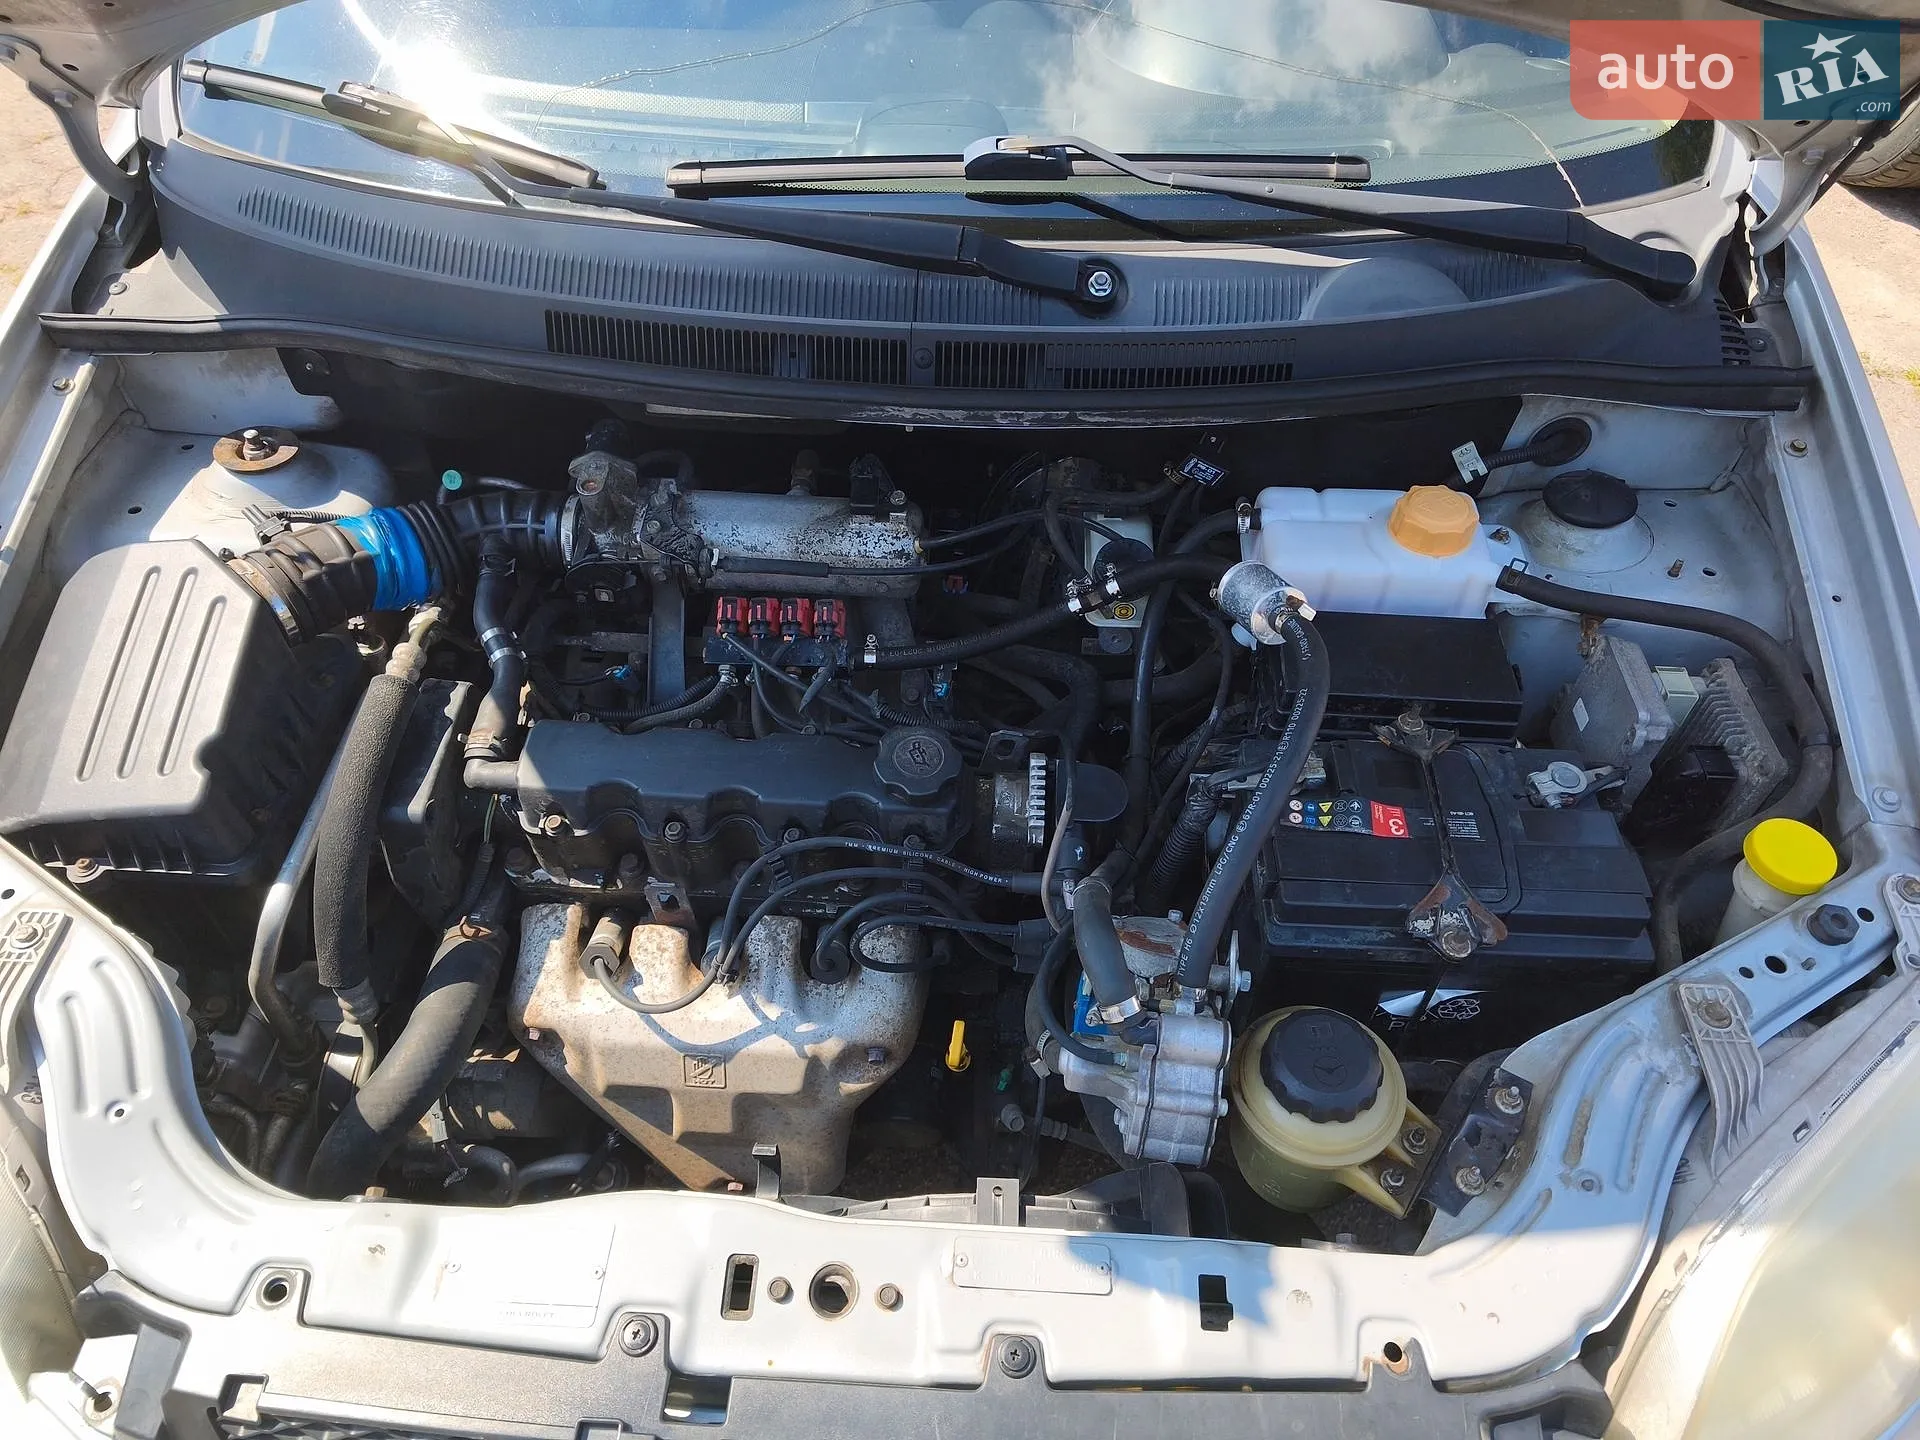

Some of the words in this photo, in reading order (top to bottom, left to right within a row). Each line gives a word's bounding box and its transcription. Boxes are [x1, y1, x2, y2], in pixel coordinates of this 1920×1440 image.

[902, 850, 934, 860] SILICONE
[963, 867, 979, 878] HIGH
[979, 873, 1003, 884] POWER
[1178, 954, 1189, 976] TYPE
[1184, 939, 1193, 951] H6
[1215, 835, 1239, 875] LPG/CNG
[1243, 791, 1263, 820] 67R-01
[1260, 751, 1284, 789] 00225-21
[1283, 723, 1297, 741] R110
[1291, 688, 1308, 721] 00225-22
